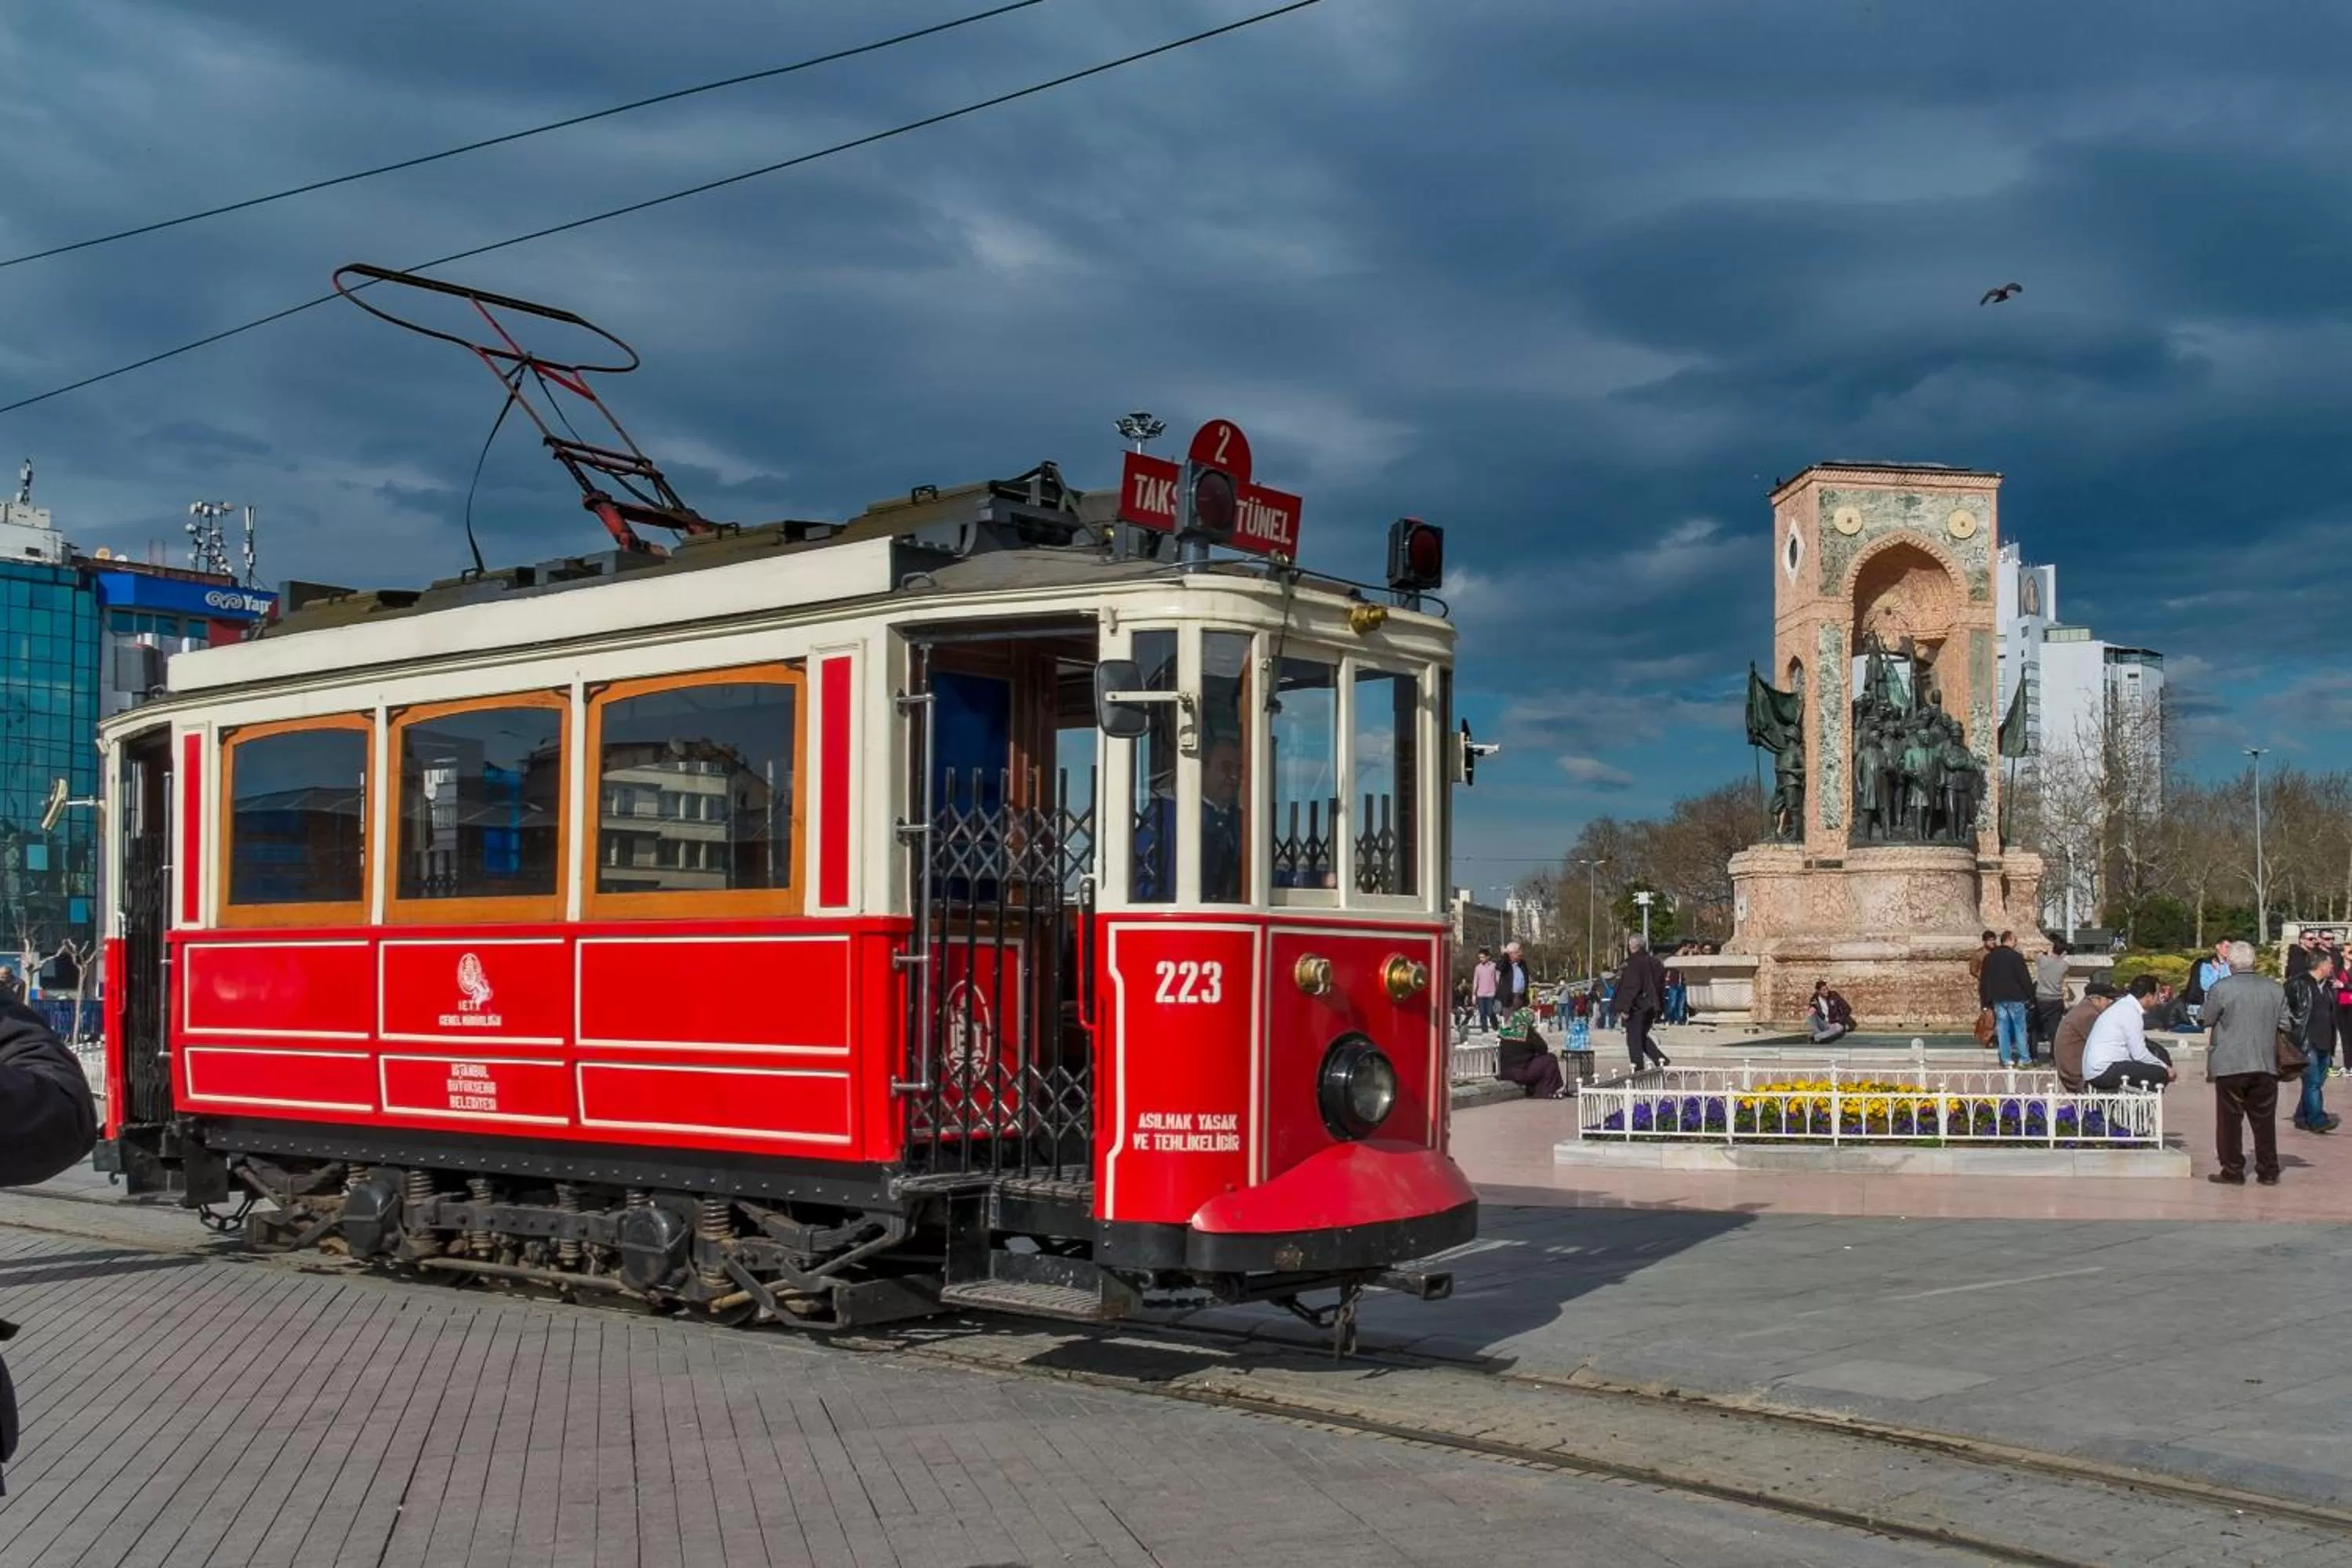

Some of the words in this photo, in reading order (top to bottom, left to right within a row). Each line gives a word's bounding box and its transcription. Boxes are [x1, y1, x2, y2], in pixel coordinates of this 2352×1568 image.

[1214, 425, 1232, 465] 2
[1134, 473, 1178, 516] TAKS
[1236, 496, 1293, 545] TÜNEL
[1155, 960, 1222, 1004] 223
[1132, 1132, 1150, 1151] VE
[1138, 1112, 1192, 1131] ASILMAK
[1197, 1113, 1238, 1131] YASAK
